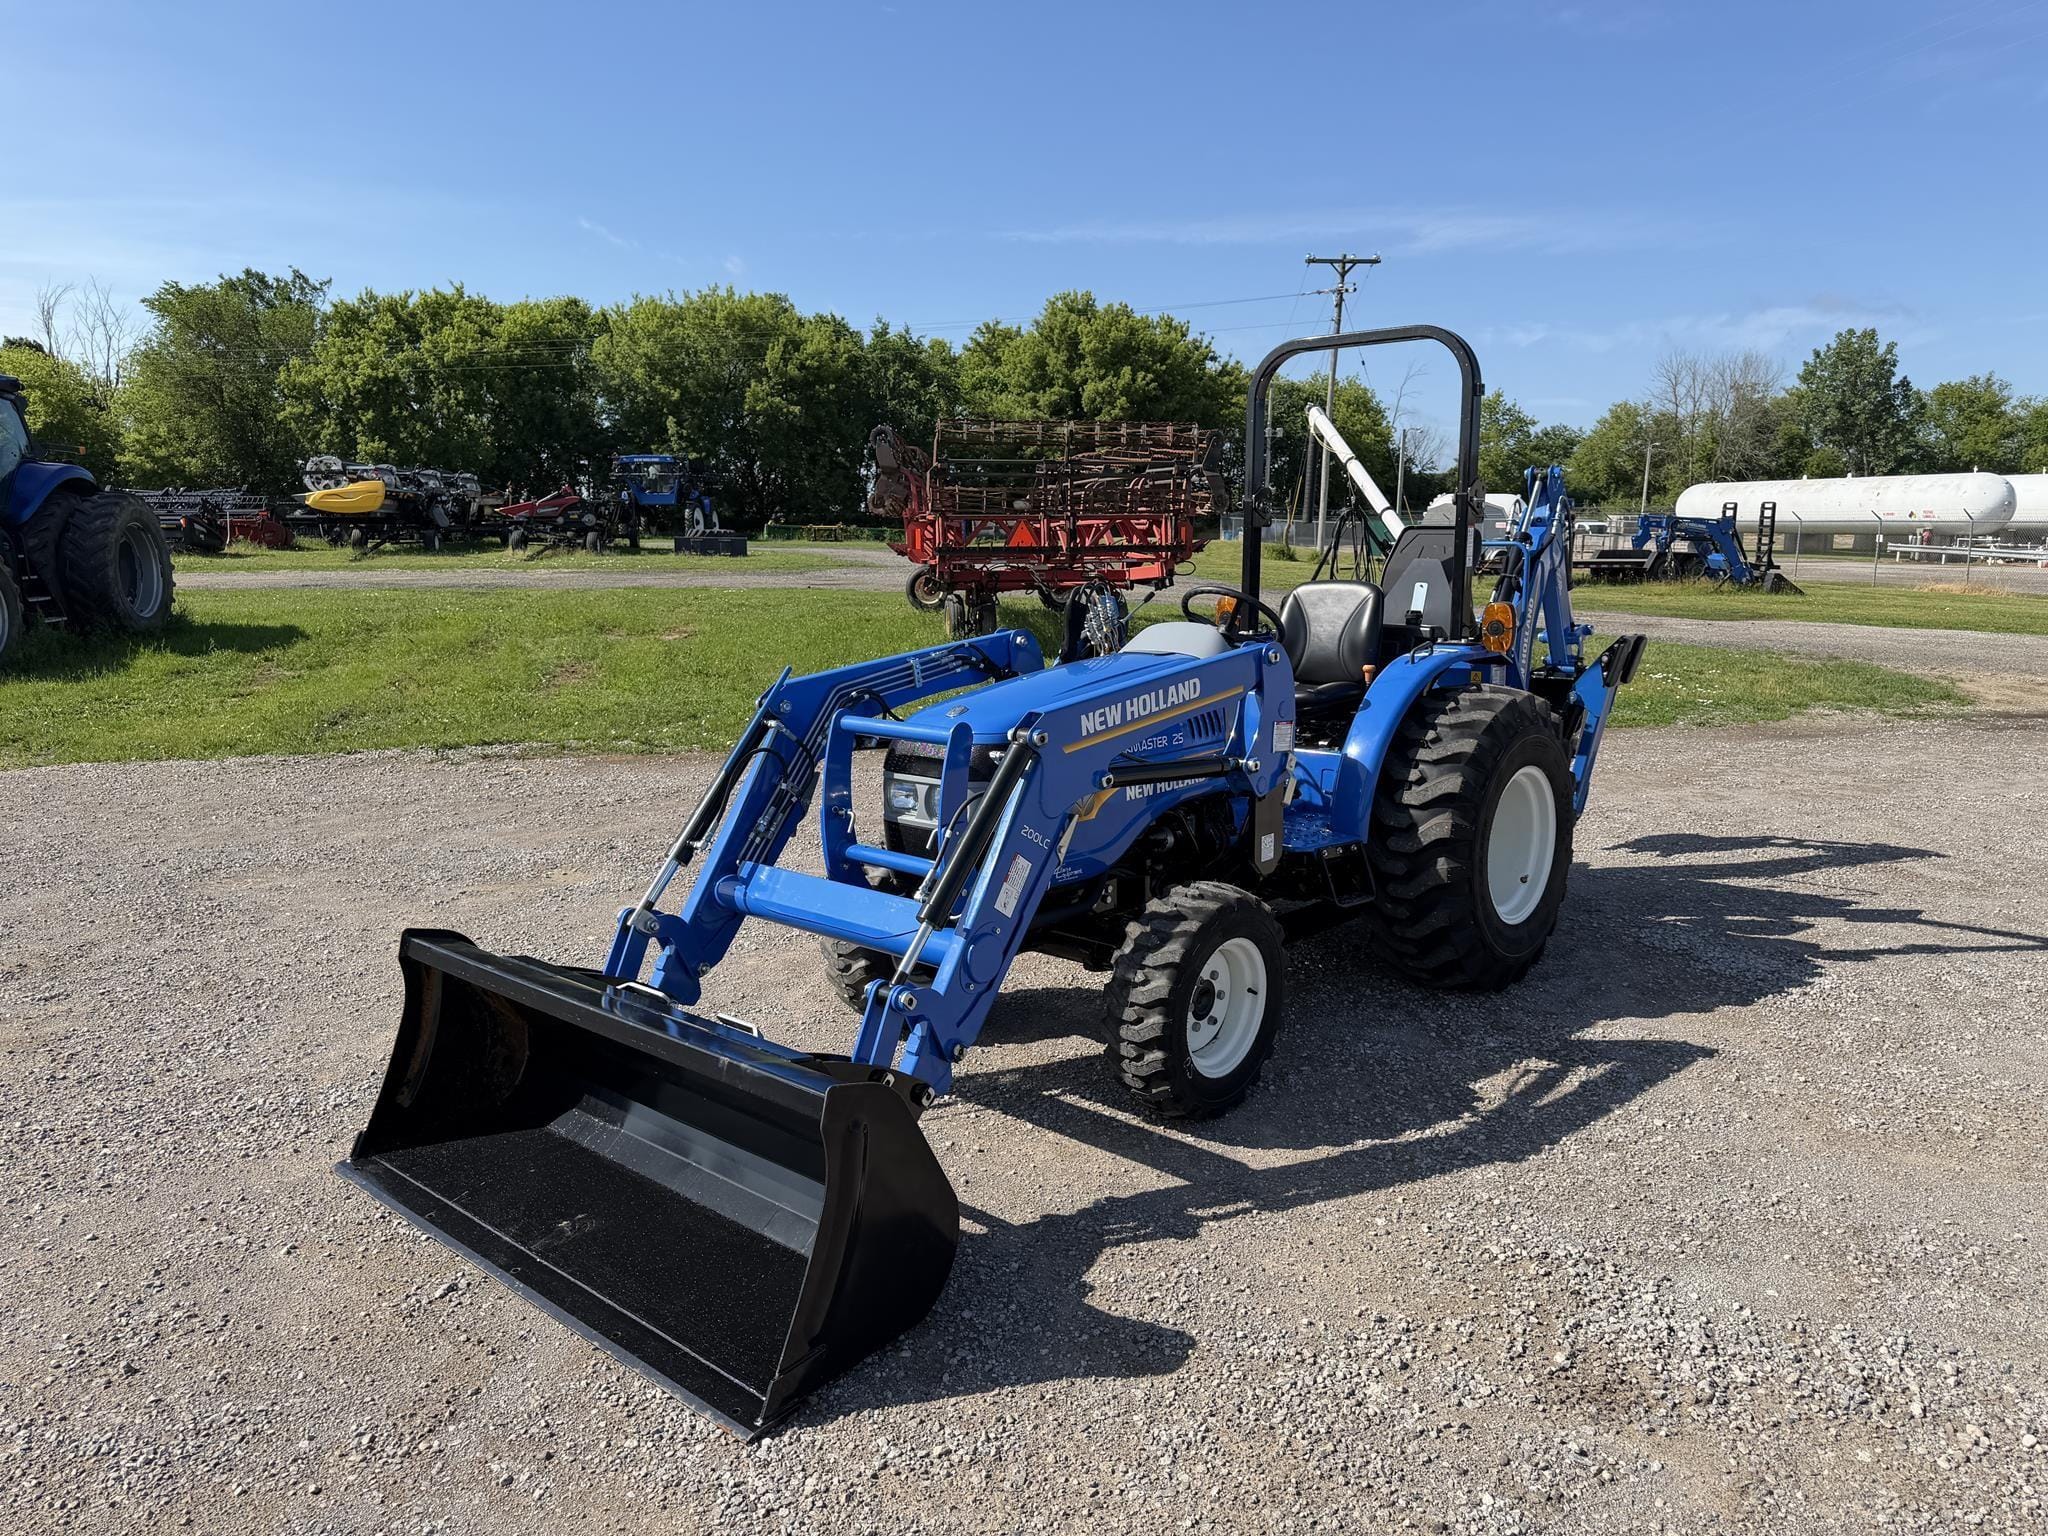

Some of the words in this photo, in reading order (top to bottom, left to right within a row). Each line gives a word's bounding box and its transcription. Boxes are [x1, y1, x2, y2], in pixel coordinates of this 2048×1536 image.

[1081, 702, 1122, 736] NEW
[1125, 678, 1201, 721] HOLLAND
[1172, 732, 1184, 745] 25
[1126, 783, 1154, 801] NEW
[1021, 824, 1051, 849] 200LC
